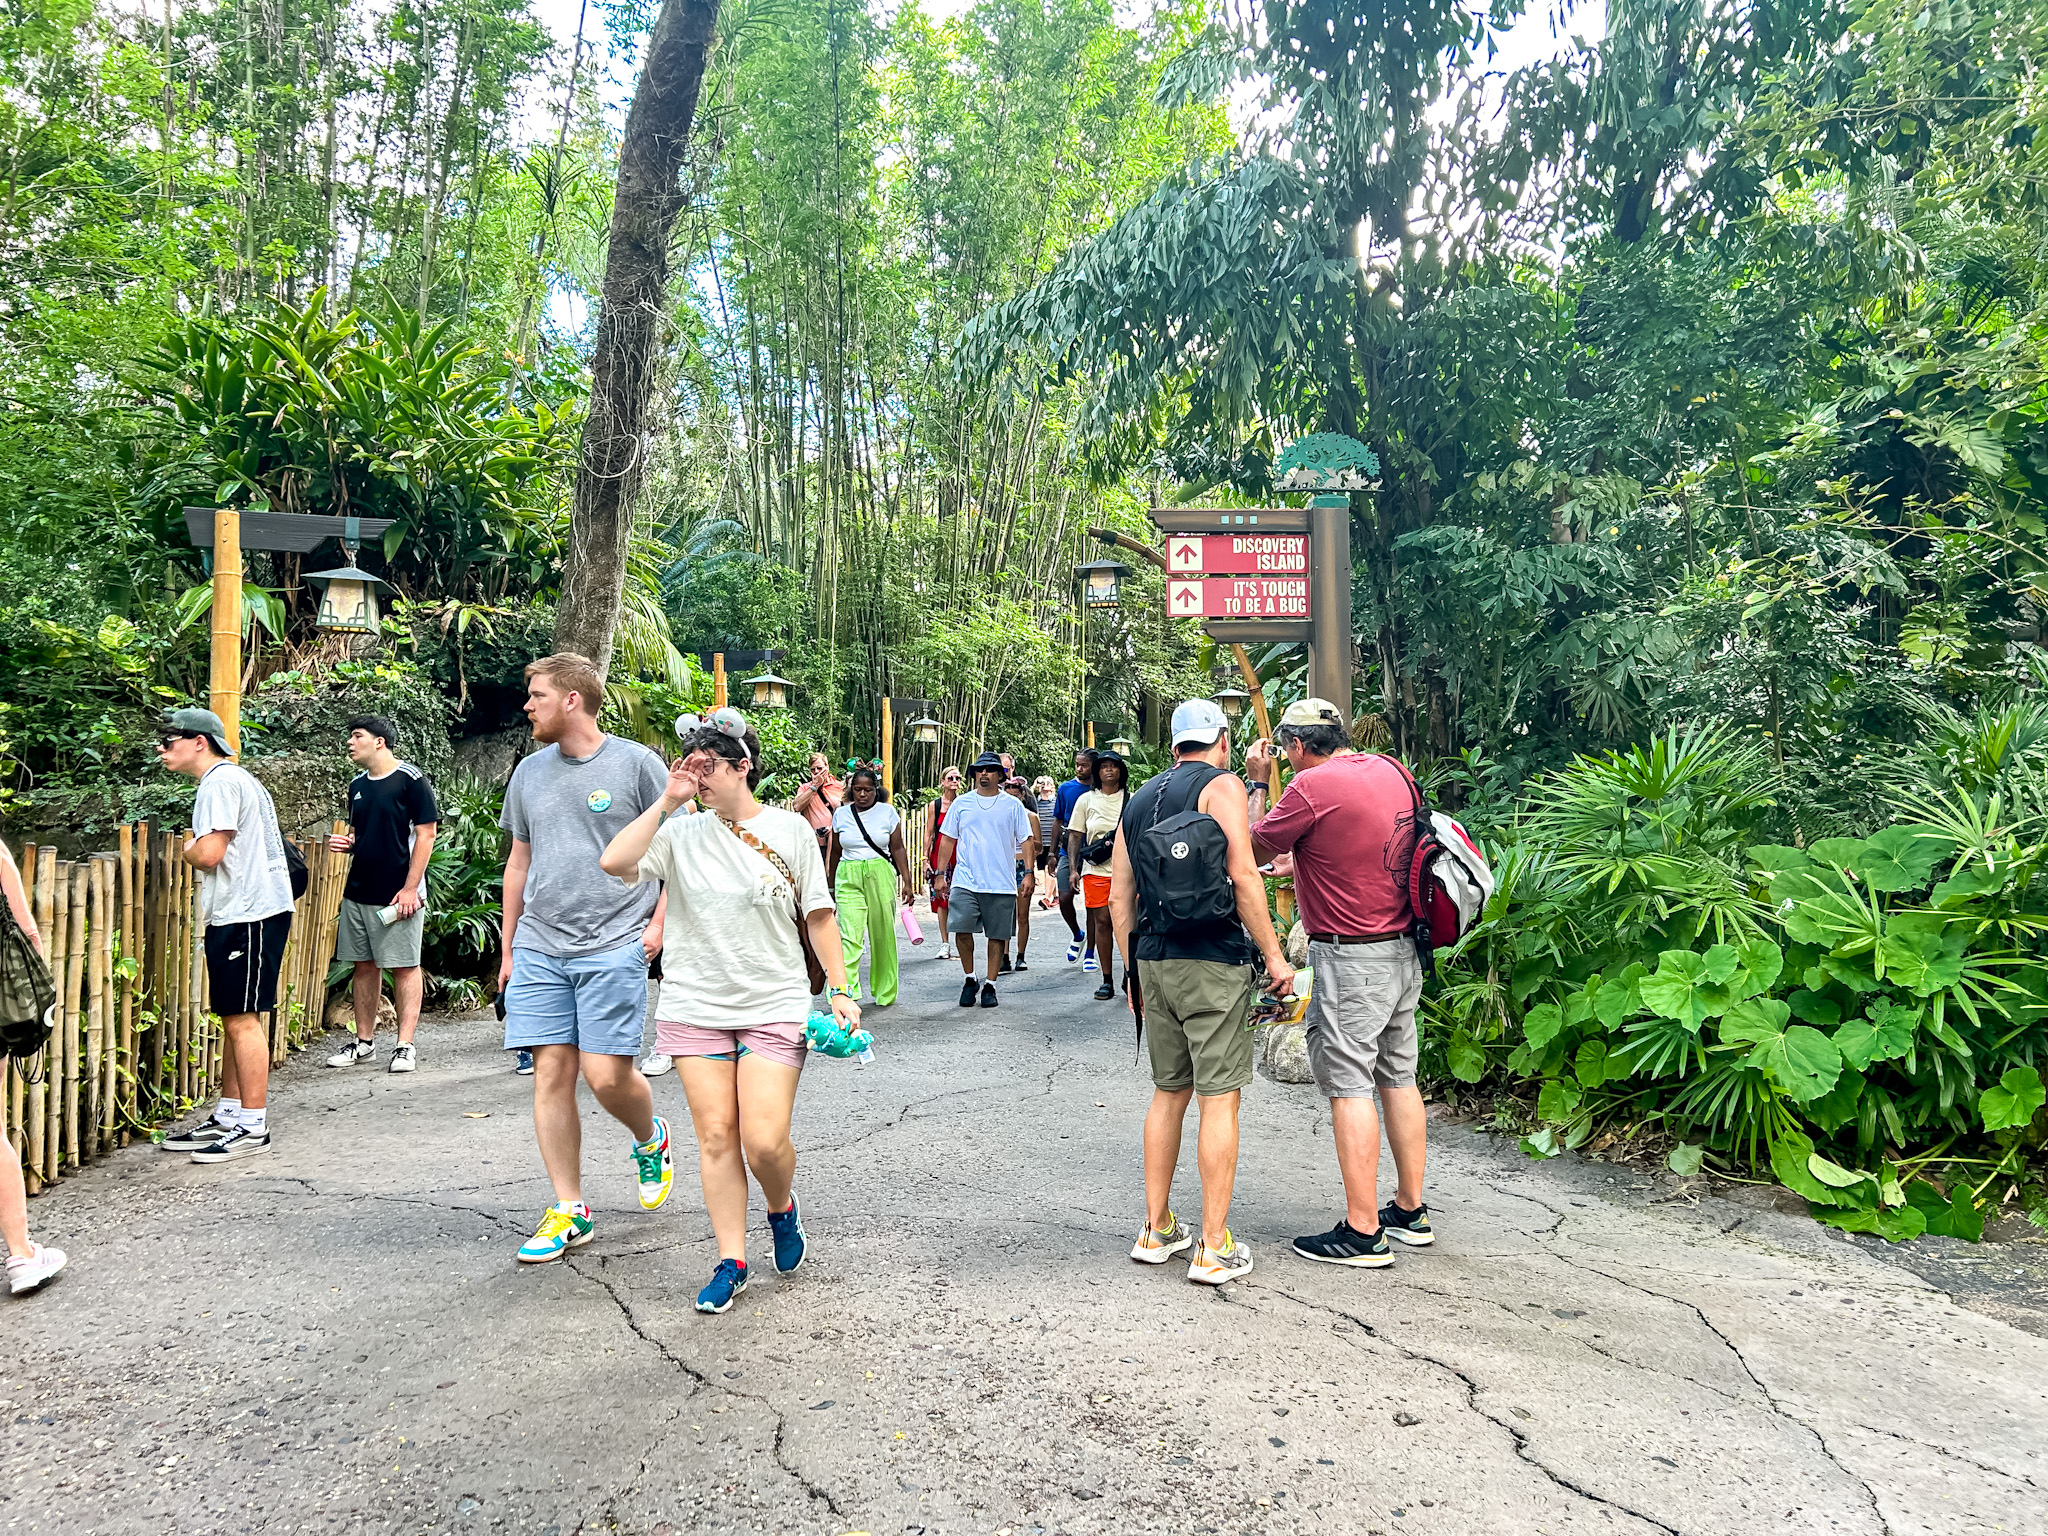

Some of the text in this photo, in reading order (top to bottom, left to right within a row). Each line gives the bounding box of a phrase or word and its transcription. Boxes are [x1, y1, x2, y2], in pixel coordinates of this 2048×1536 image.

[1232, 537, 1305, 554] DISCOVERY
[1256, 554, 1306, 570] ISLAND
[1233, 581, 1306, 597] IT'S TOUGH
[1223, 597, 1307, 614] TO BE A BUG
